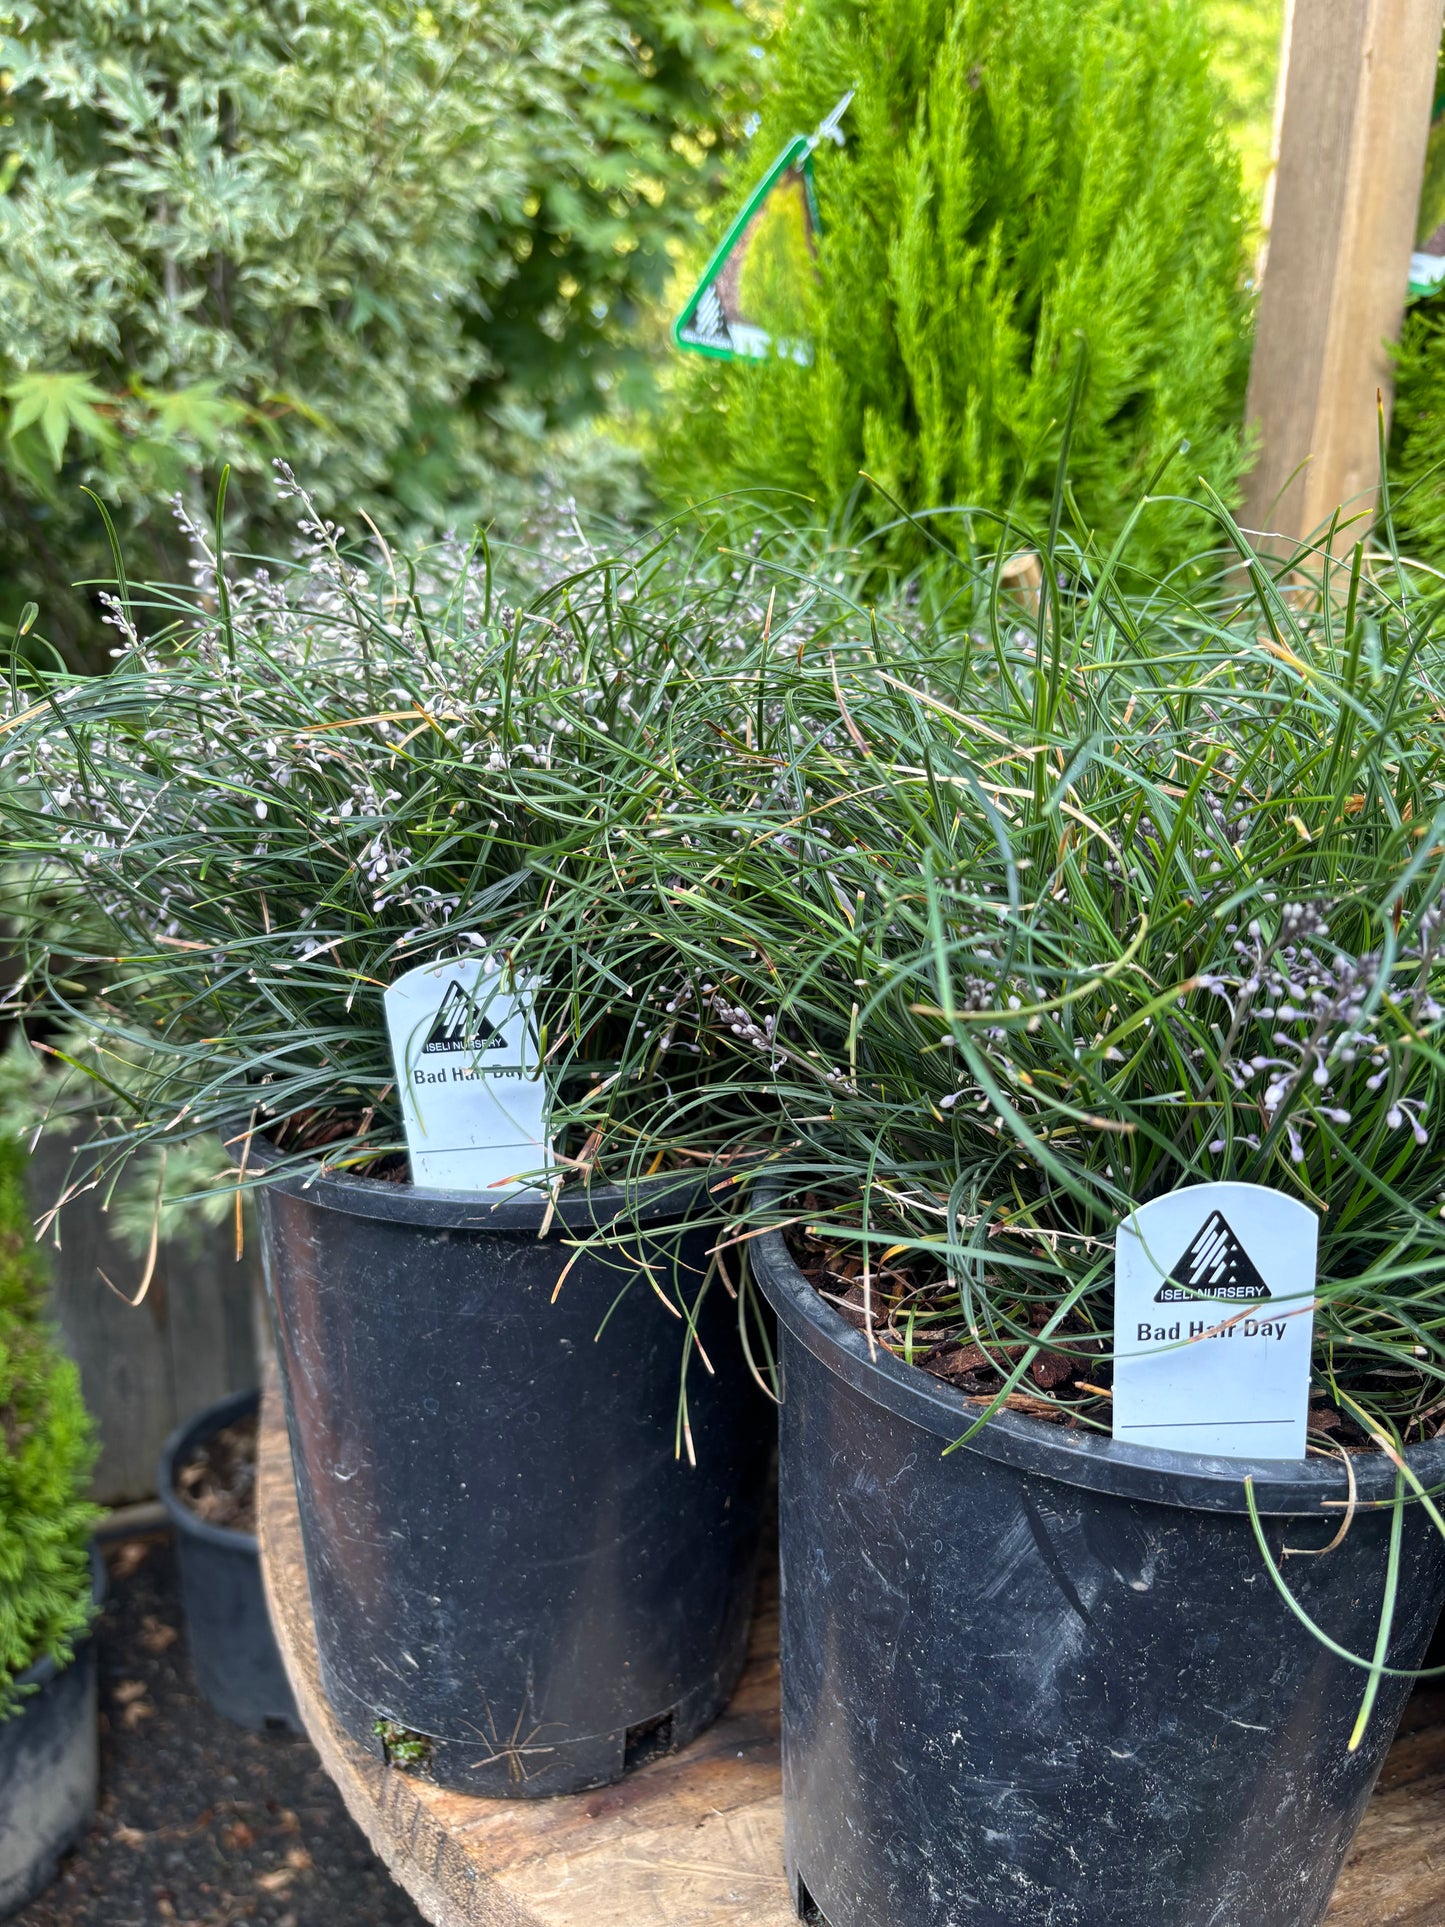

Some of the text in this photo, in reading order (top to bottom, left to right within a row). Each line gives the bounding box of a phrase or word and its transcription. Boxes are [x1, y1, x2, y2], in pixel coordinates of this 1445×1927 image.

[426, 1041, 451, 1053] ISELI
[414, 1068, 447, 1085] Bad
[1160, 1285, 1265, 1301] ISELI NURSERY
[1137, 1321, 1181, 1341] Bad
[1244, 1318, 1288, 1341] Day
